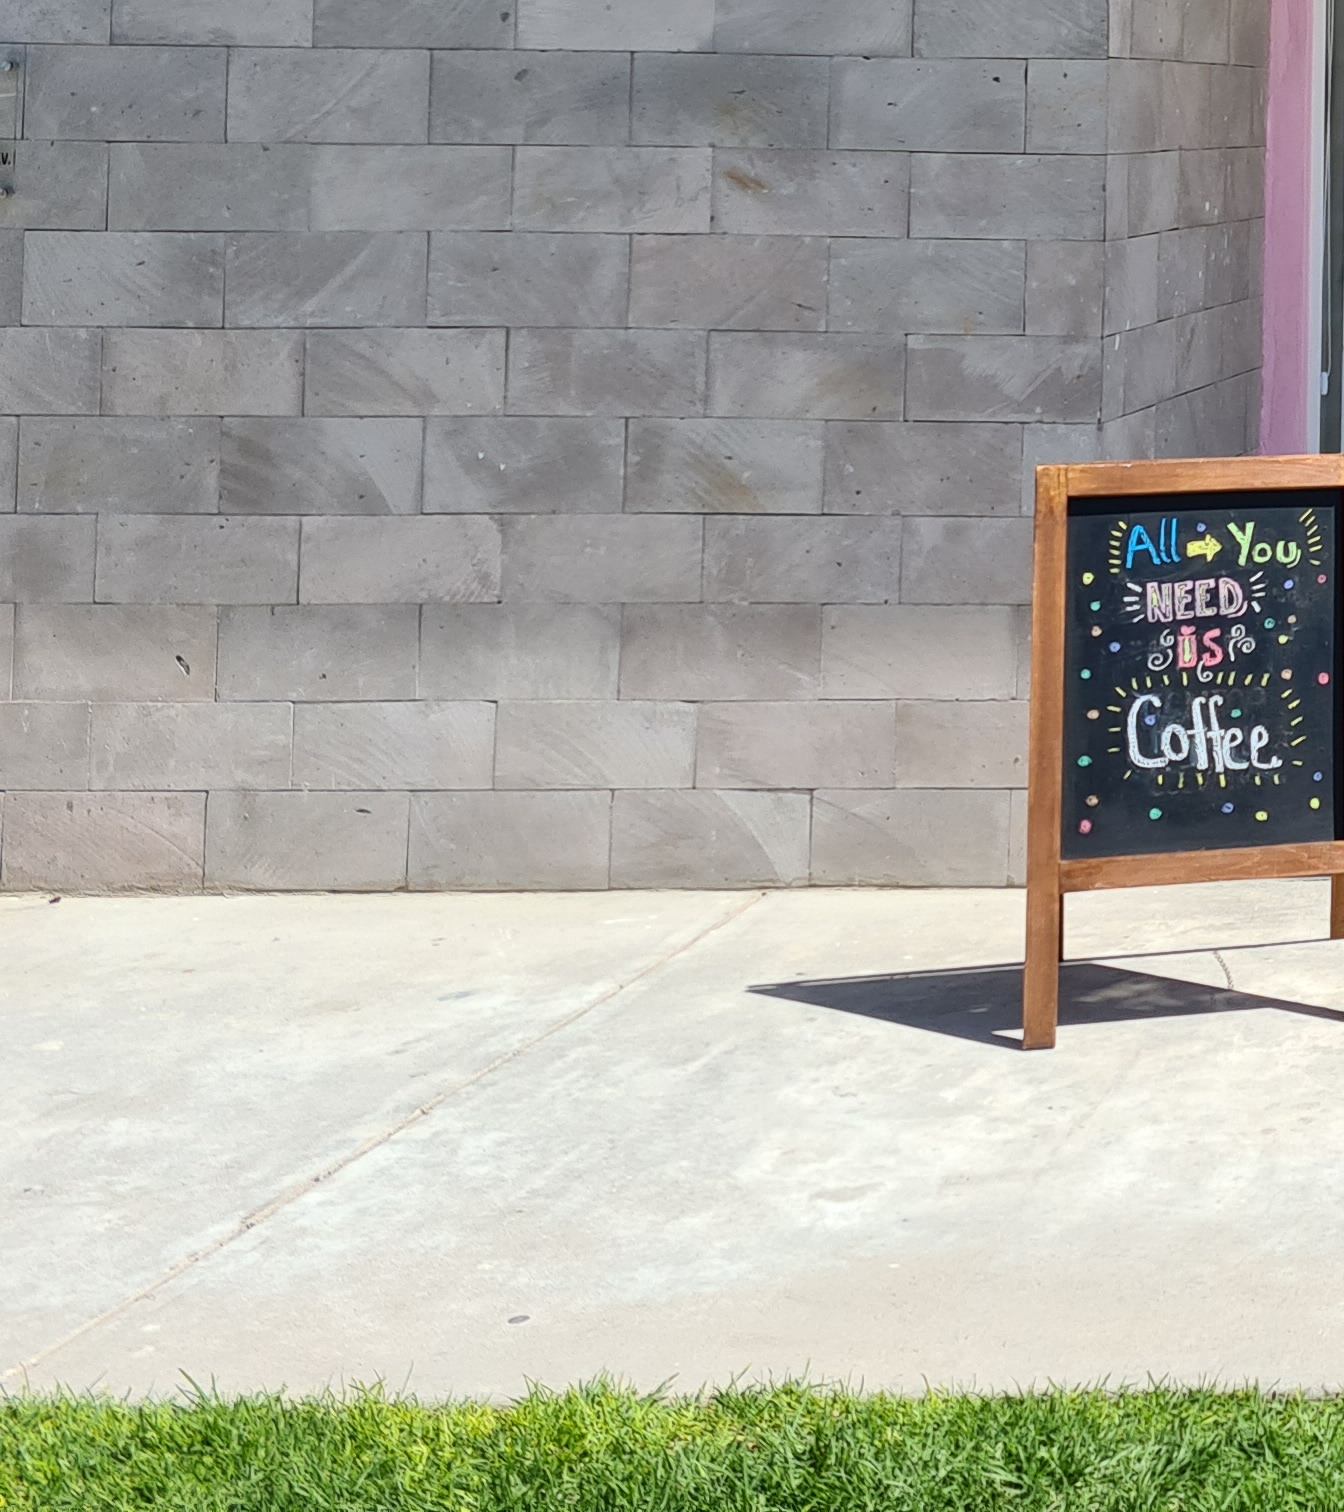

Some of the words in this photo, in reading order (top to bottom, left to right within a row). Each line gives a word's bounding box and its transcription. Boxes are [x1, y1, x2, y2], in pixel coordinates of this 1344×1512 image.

[1126, 517, 1182, 569] All
[1227, 521, 1301, 568] You
[1146, 577, 1248, 623] NEED
[1126, 693, 1283, 773] Coffee
